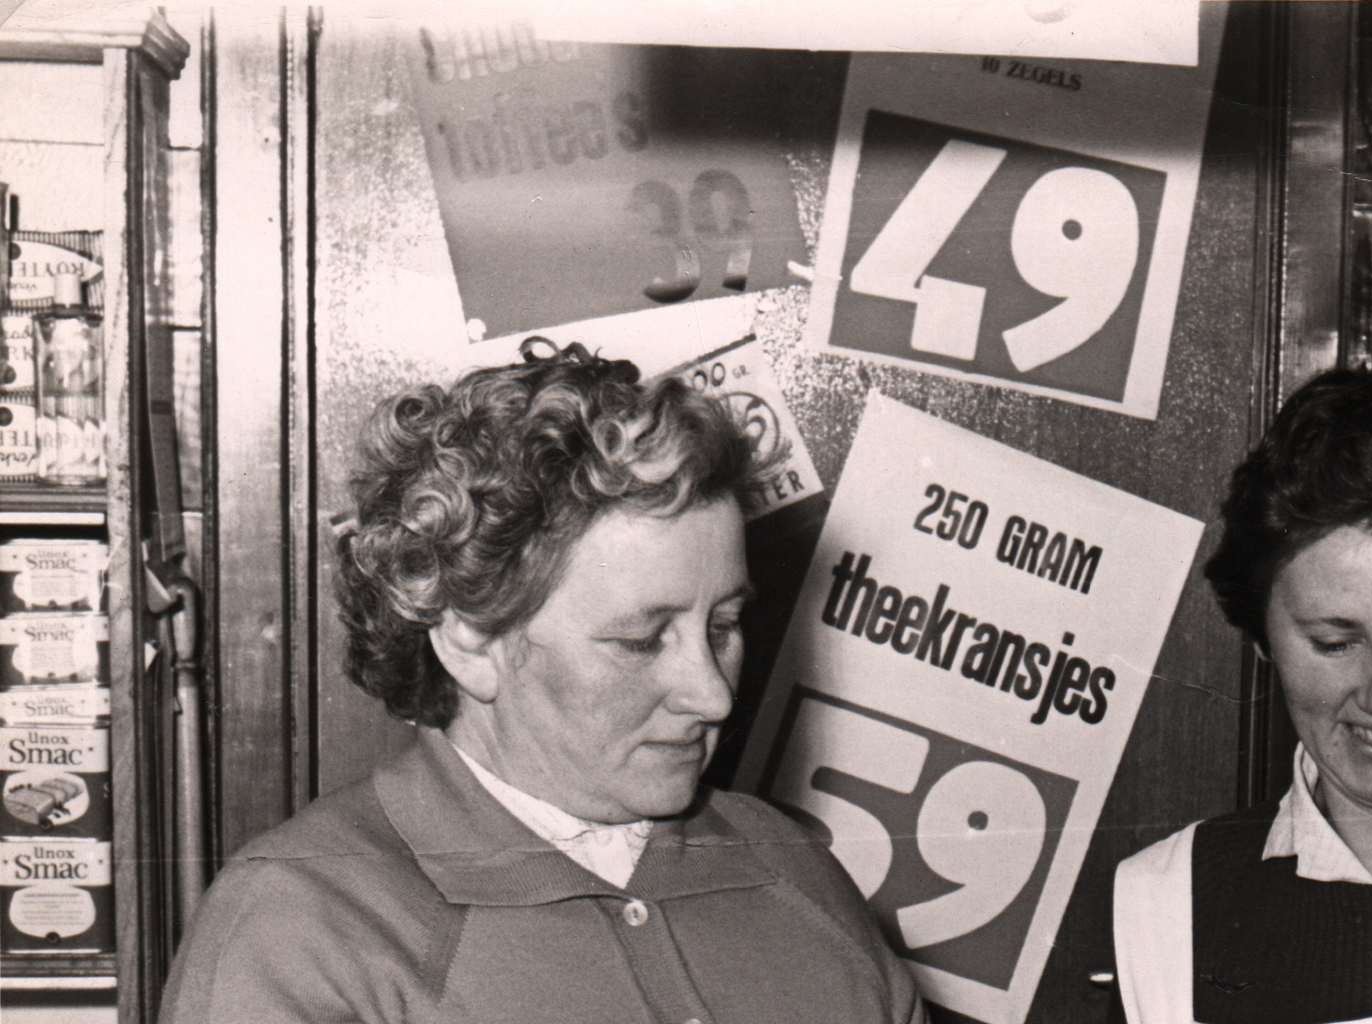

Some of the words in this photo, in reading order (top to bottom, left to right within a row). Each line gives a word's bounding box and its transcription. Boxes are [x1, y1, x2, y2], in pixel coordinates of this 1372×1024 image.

[1006, 59, 1083, 92] ZEGELS
[850, 139, 1139, 373] 49
[914, 483, 989, 550] 250
[996, 514, 1103, 594] GRAM
[25, 553, 76, 570] Smac
[23, 627, 75, 643] Smac
[820, 550, 1117, 725] theekransjes
[23, 701, 74, 717] Smac
[28, 731, 70, 746] Unox
[8, 738, 83, 766] Smac
[770, 698, 1047, 950] 59
[33, 846, 75, 860] Unox
[14, 856, 88, 881] Smac
